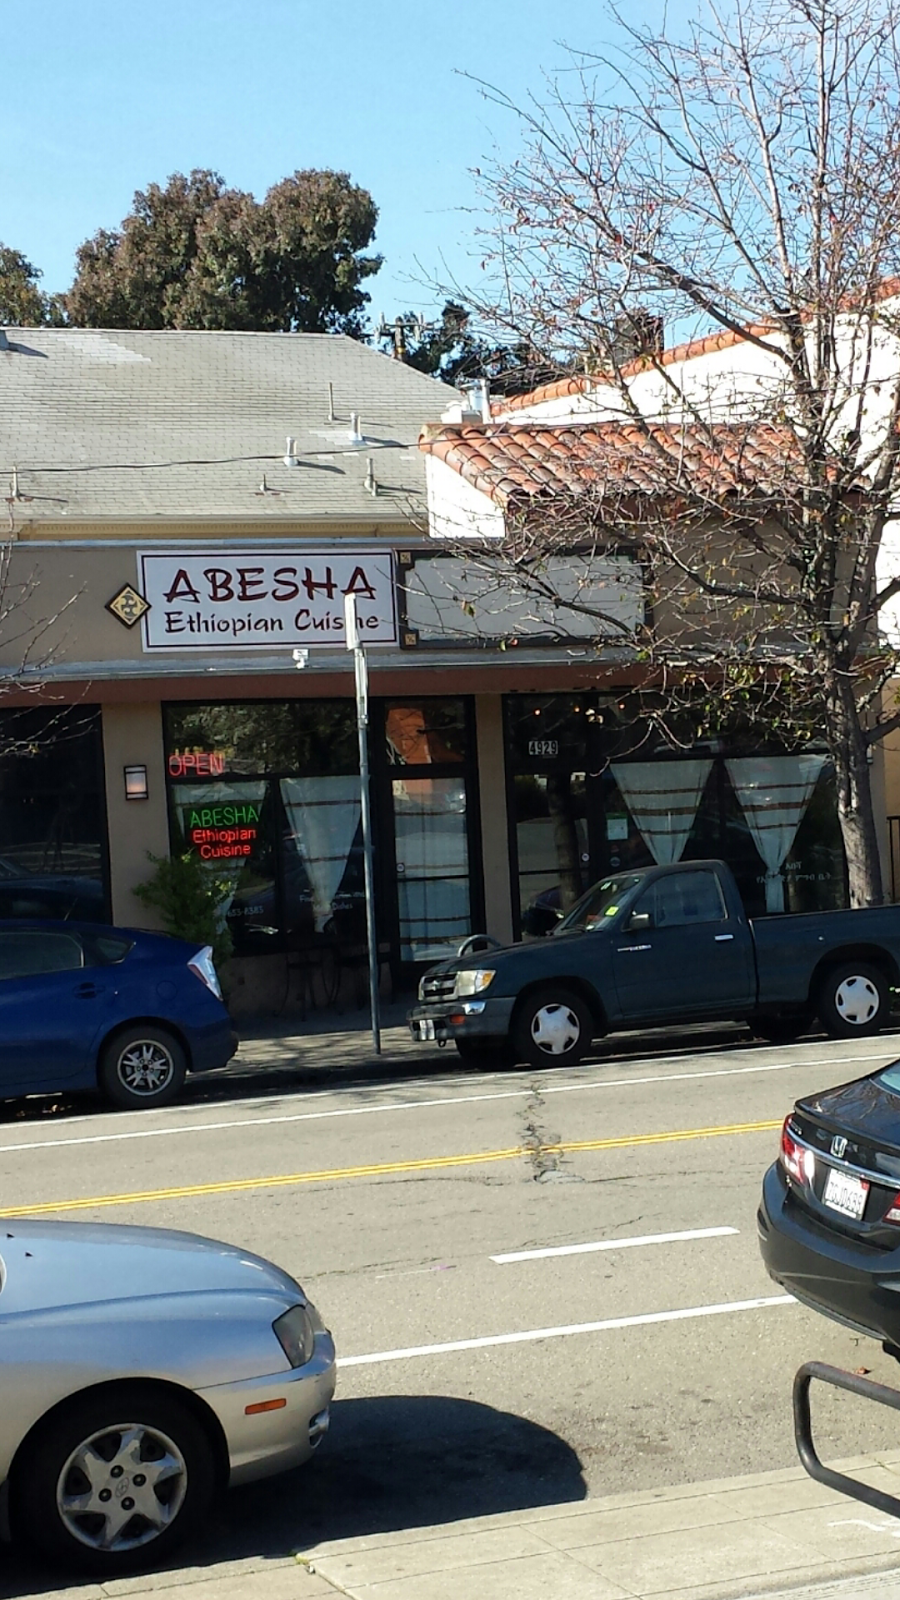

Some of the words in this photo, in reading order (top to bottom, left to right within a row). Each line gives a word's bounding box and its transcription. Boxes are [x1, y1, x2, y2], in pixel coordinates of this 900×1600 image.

[162, 566, 377, 604] ABESHA
[164, 611, 284, 637] Ethiopian
[294, 609, 379, 632] Cuisne
[529, 741, 558, 755] 4929
[168, 753, 224, 776] OPEN
[189, 805, 259, 828] ABESHA
[192, 828, 257, 844] Ethiopian
[200, 844, 251, 859] Cuisine
